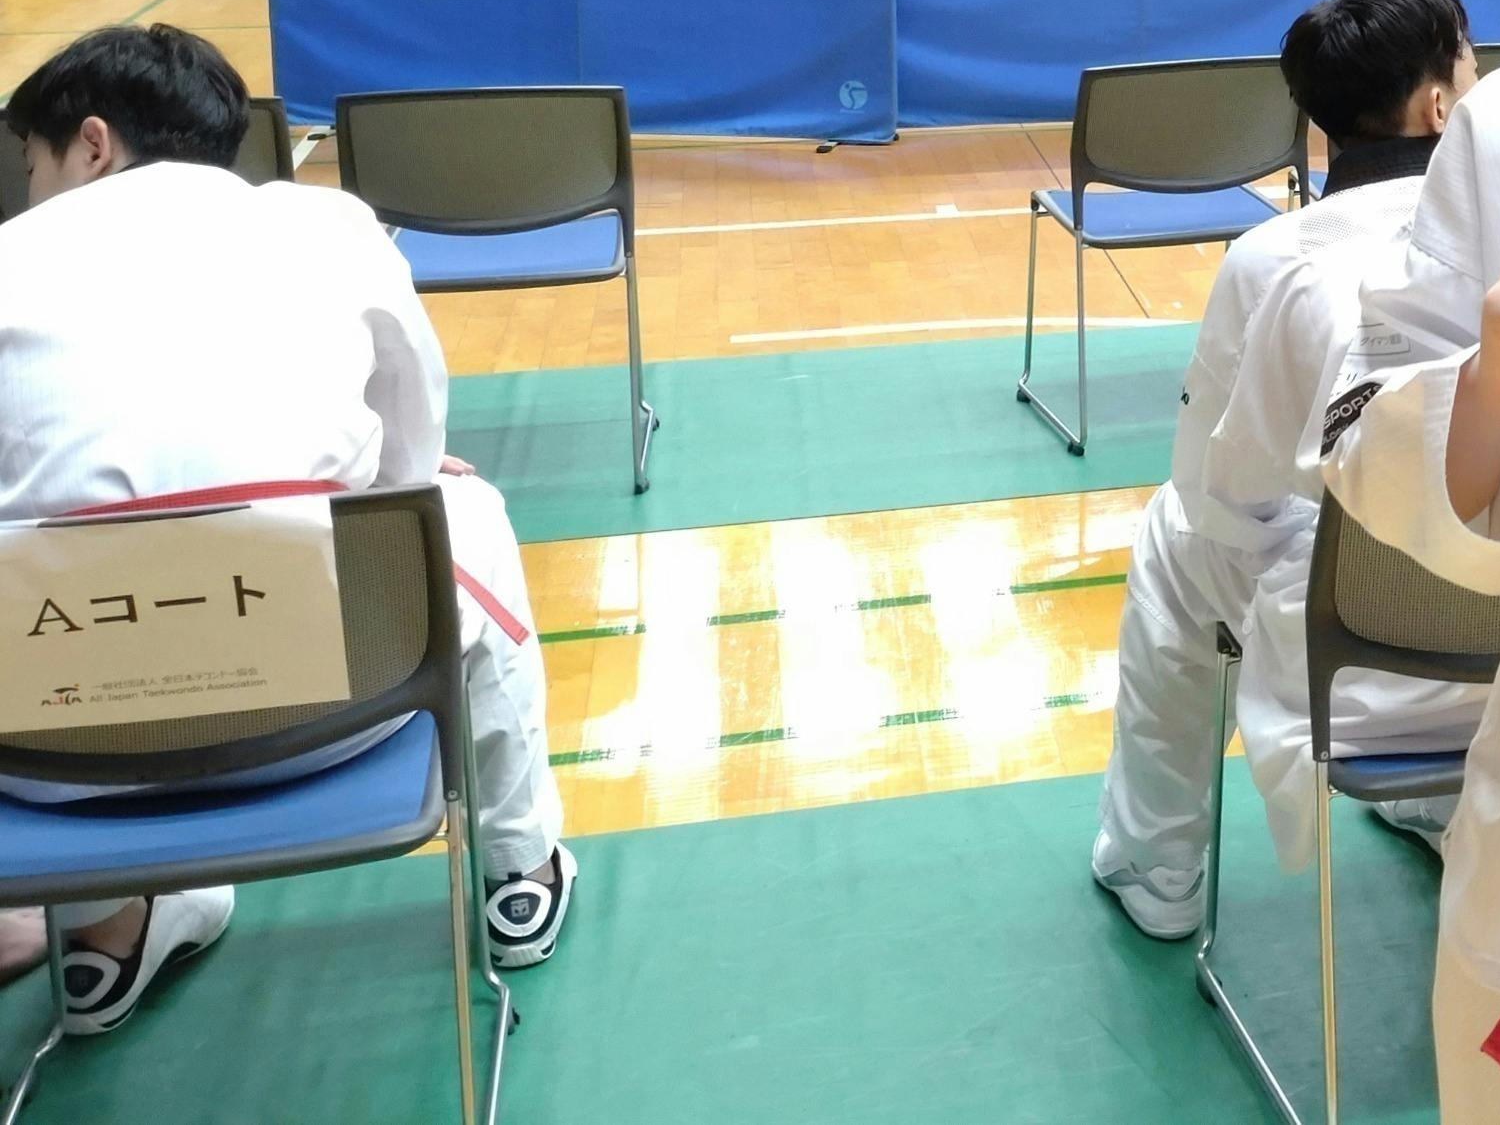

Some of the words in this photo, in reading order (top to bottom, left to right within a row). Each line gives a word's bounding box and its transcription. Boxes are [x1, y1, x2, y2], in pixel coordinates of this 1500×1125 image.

[27, 575, 266, 637] Aコート
[108, 691, 138, 703] Japan
[143, 685, 203, 698] Taekwondo
[206, 678, 268, 692] Association
